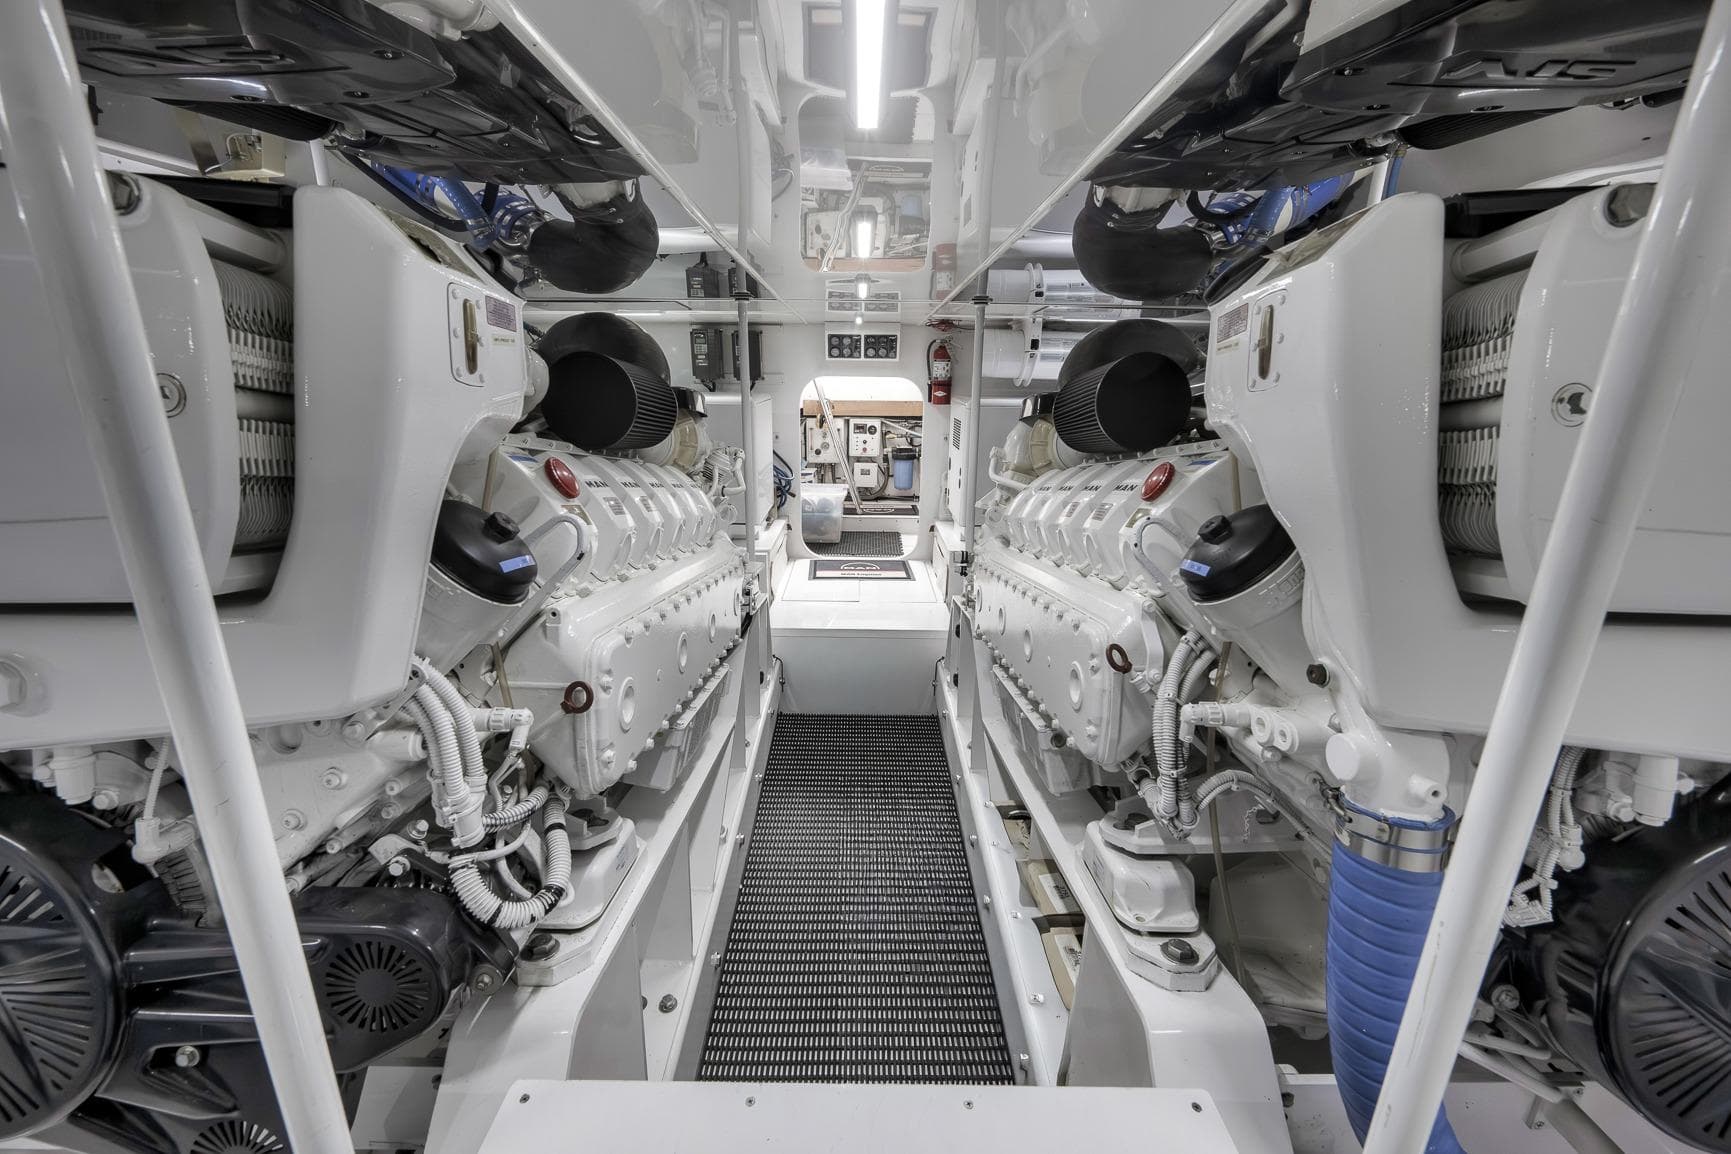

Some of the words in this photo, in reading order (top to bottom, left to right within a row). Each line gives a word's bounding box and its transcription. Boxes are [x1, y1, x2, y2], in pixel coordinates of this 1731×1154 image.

[584, 480, 609, 488] MAN
[620, 480, 641, 488] MAN
[1081, 484, 1102, 492] MAN
[1113, 484, 1138, 492] MAN
